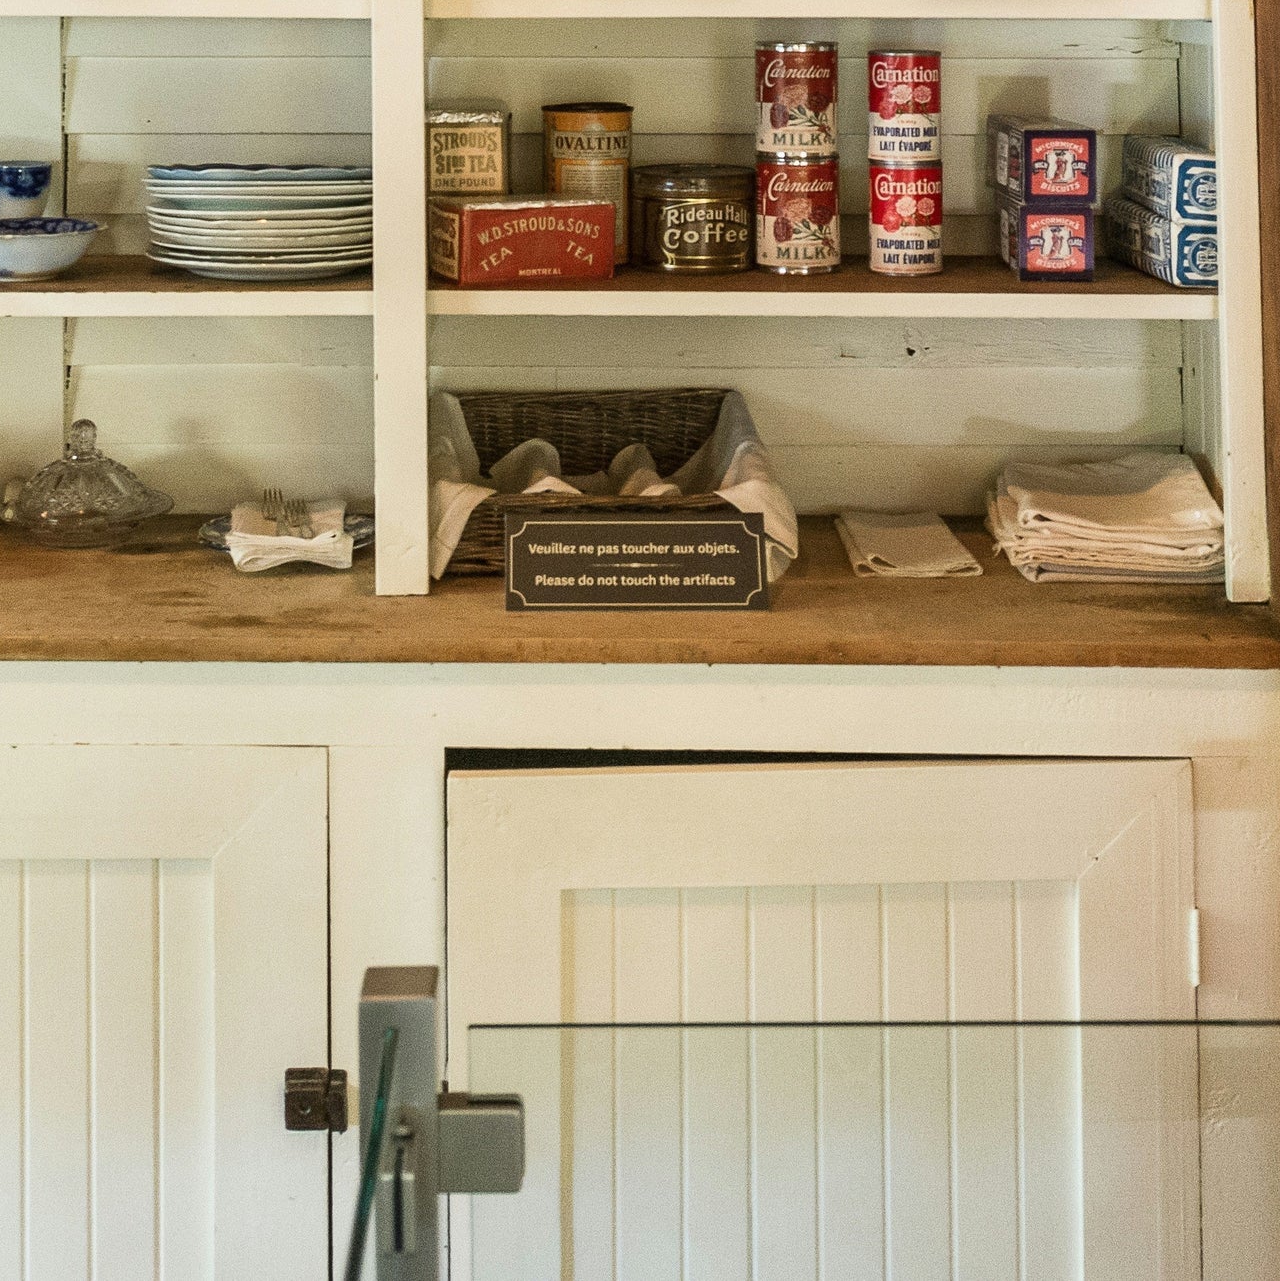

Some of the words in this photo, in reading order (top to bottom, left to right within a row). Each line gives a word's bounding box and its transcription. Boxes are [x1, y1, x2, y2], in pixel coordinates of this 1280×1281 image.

[764, 58, 831, 88] Carnation
[872, 61, 939, 89] Carnation
[773, 132, 821, 146] MILK
[872, 125, 921, 137] EVAPORATED
[433, 131, 498, 155] STROUD'S
[555, 135, 628, 152] OVALTINE
[468, 154, 498, 174] TEA
[434, 177, 456, 188] ONE
[459, 176, 496, 188] POUND
[767, 172, 834, 202] Carnation
[874, 173, 942, 201] Carnation
[1040, 182, 1081, 193] BISCUITS
[666, 207, 723, 228] Rideau
[725, 204, 748, 226] Hall
[504, 216, 556, 237] STROUD
[557, 219, 565, 231] &
[566, 217, 601, 240] SONS
[663, 222, 748, 250] Coffee
[566, 239, 594, 266] TEA
[776, 246, 825, 260] MILK
[876, 237, 926, 250] EVAPORATED
[479, 246, 513, 272] TEA
[528, 543, 576, 555] Veuillez
[579, 544, 594, 555] ne
[597, 544, 619, 557] pas
[622, 543, 670, 555] toucher
[672, 544, 694, 555] aux
[698, 542, 740, 557] objets.
[535, 574, 575, 587] Please
[578, 574, 594, 587] do
[597, 575, 618, 587] not
[621, 574, 657, 587] touch
[660, 574, 680, 587] the
[683, 574, 736, 587] artifacts
